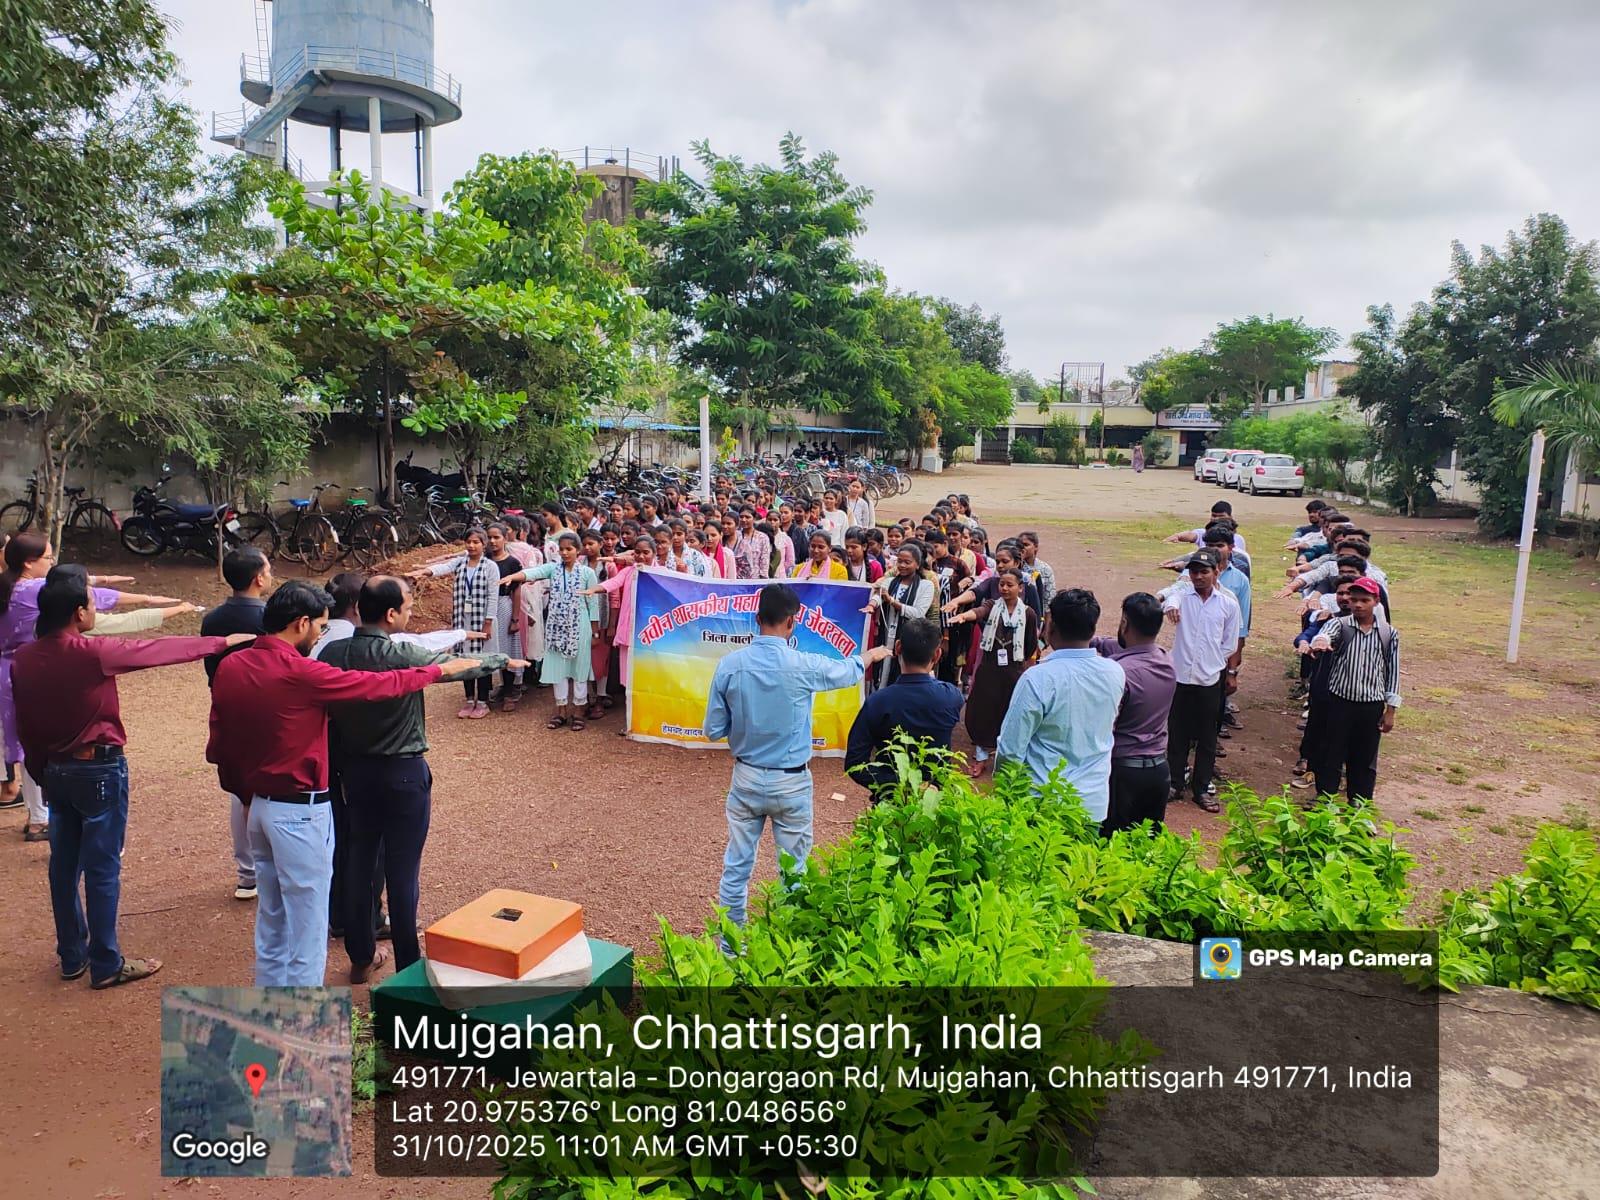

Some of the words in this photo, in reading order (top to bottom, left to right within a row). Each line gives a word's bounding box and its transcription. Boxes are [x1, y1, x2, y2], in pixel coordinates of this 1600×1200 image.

[640, 616, 673, 645] नवीन
[673, 594, 729, 625] शासकीय
[806, 606, 857, 658] जेवरतला
[703, 630, 727, 643] जिला
